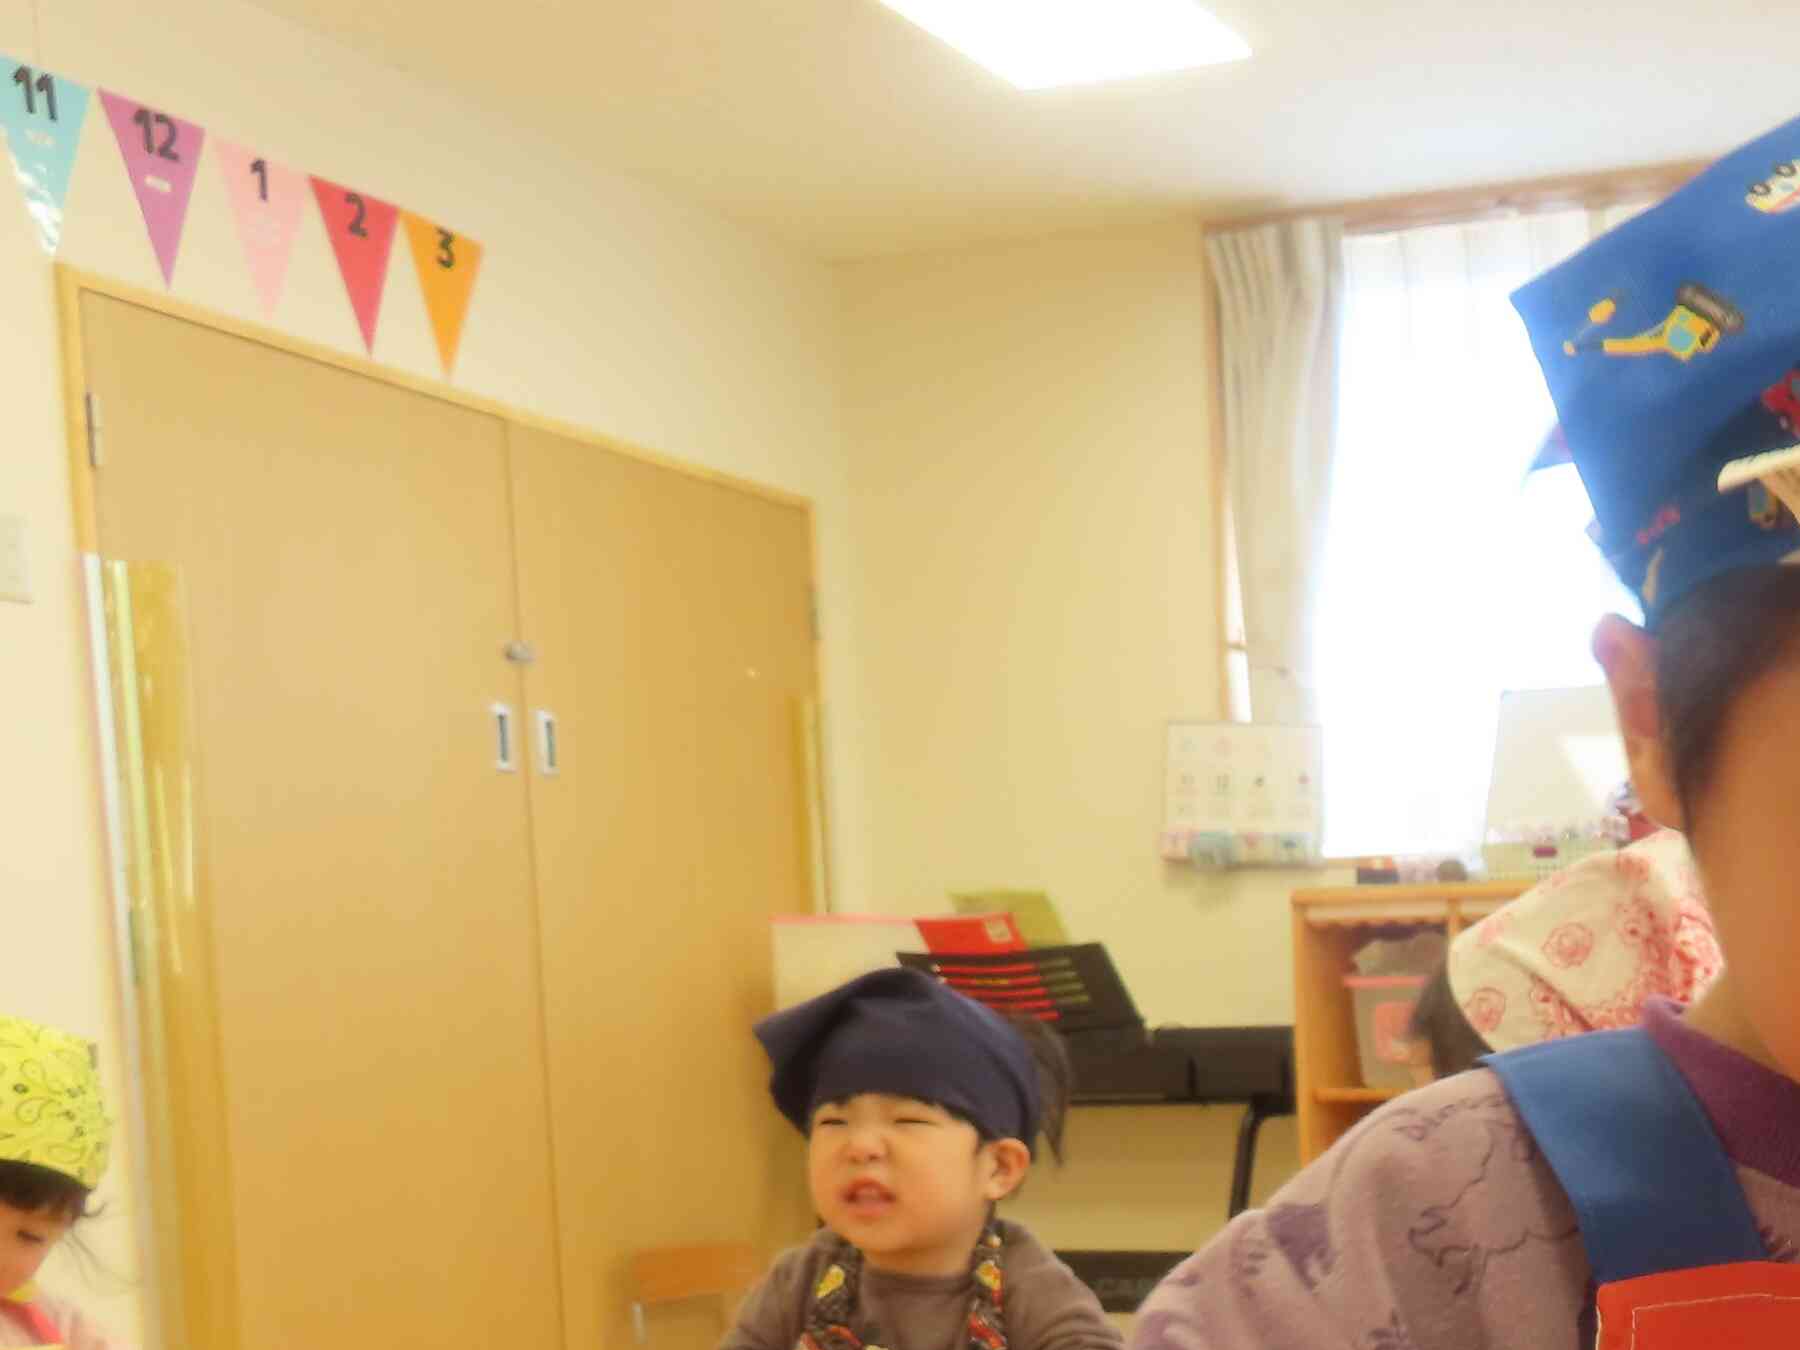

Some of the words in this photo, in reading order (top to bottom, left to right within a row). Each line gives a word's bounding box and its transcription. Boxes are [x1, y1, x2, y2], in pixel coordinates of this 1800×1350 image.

[12, 65, 58, 122] 11
[133, 108, 180, 161] 12
[250, 158, 267, 202] 1
[344, 192, 369, 239] 2
[435, 226, 454, 269] 3
